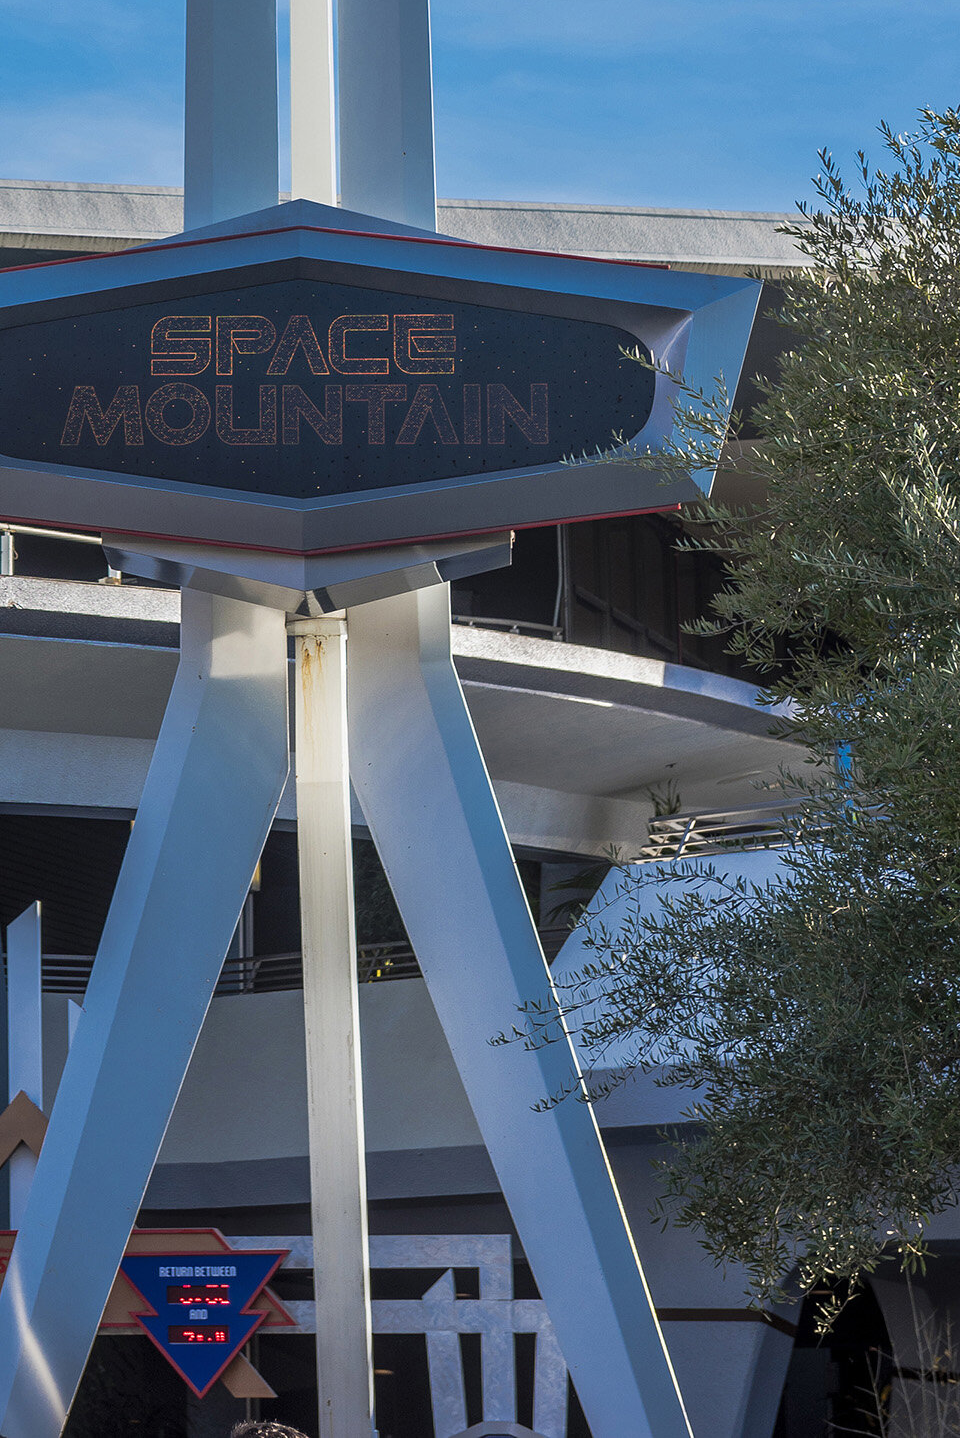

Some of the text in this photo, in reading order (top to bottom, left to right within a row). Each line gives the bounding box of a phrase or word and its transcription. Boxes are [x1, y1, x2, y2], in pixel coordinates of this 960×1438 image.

[150, 313, 457, 376] SPACE
[59, 382, 550, 446] MOUNTAIN
[159, 1266, 237, 1277] RETURN BETWEEN
[189, 1309, 208, 1320] AND
